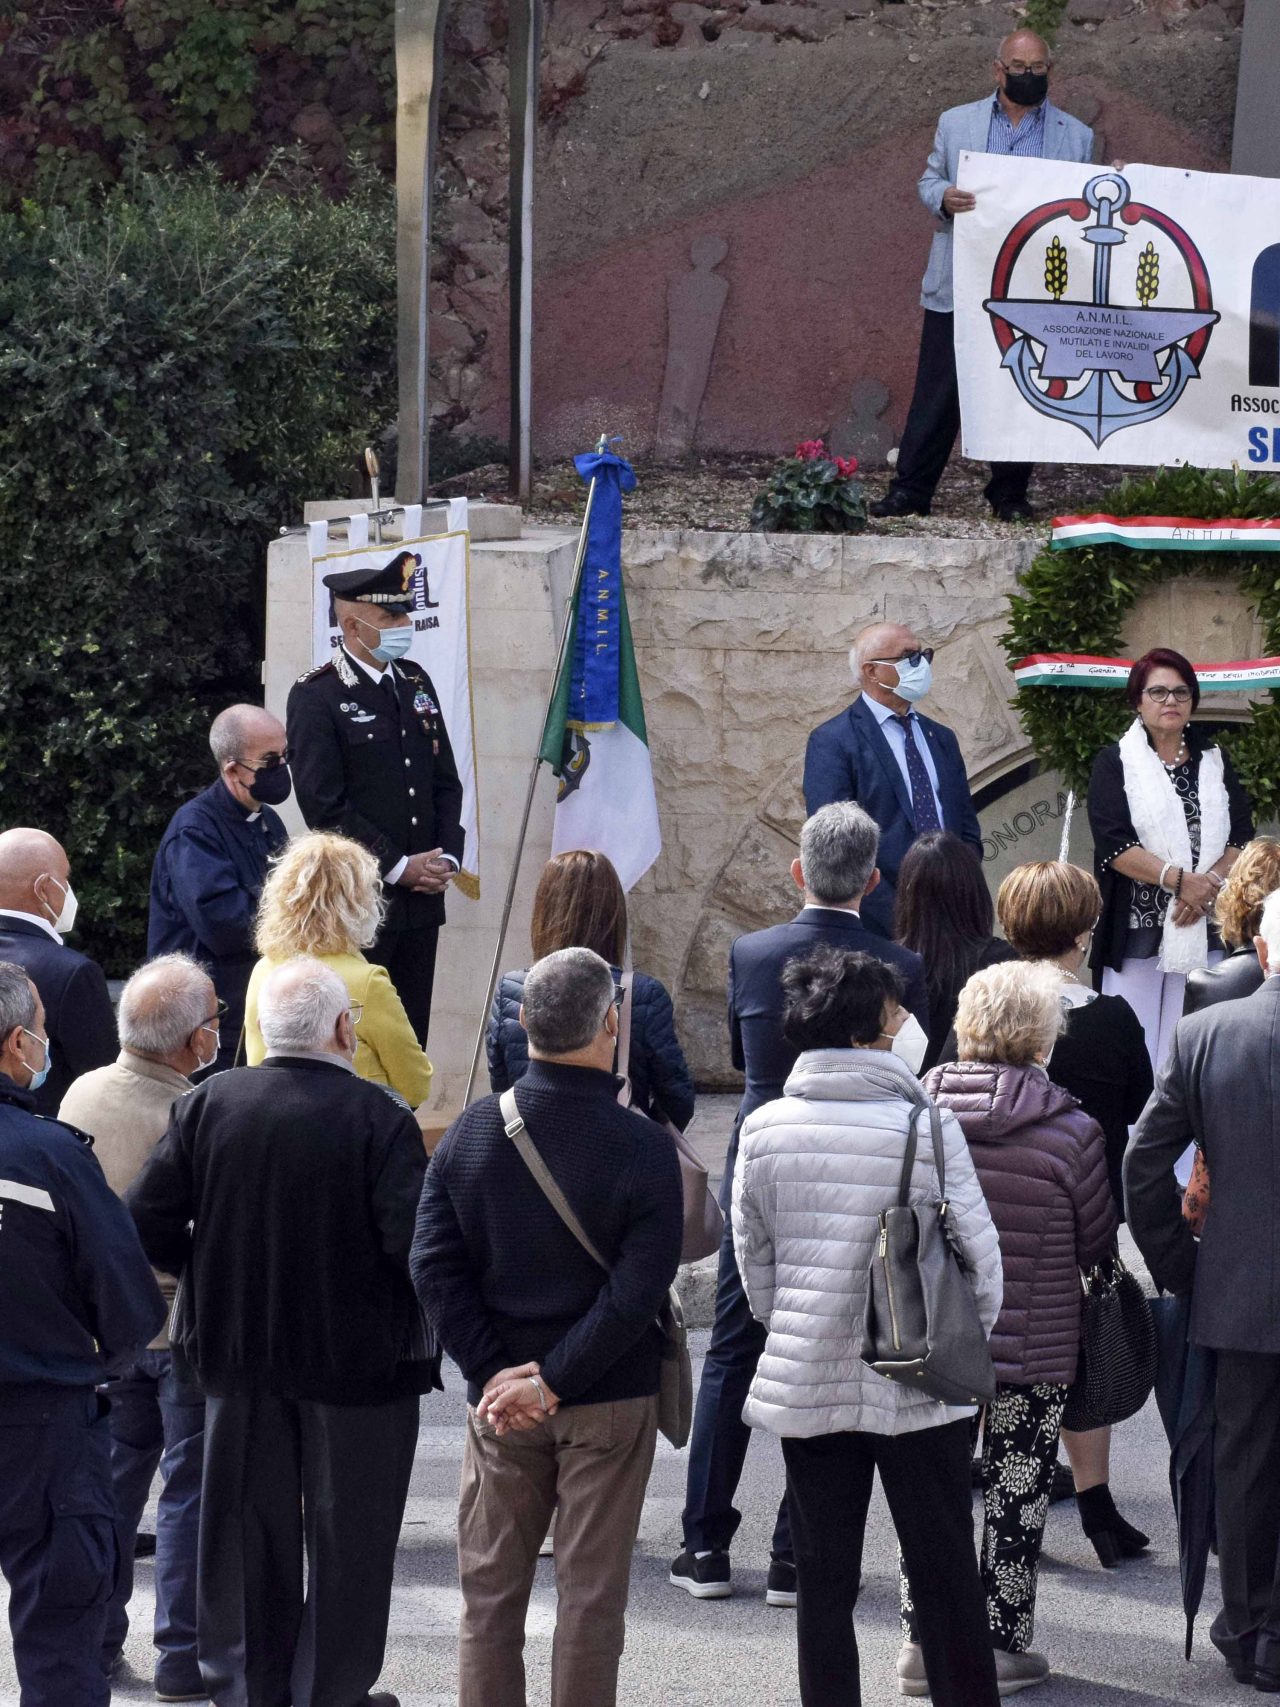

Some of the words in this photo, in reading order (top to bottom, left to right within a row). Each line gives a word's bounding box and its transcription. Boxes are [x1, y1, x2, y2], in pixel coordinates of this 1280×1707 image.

[1076, 311, 1133, 326] A.N.M.I.L.
[1043, 325, 1112, 337] ASSOCIAZIONE
[1113, 329, 1165, 341] NAZIONALE
[1059, 337, 1102, 348] MUTILATI
[1104, 340, 1110, 348] E
[1112, 341, 1150, 351] INVALIDI
[1076, 349, 1094, 359] DEL
[1097, 350, 1134, 361] LAVORO
